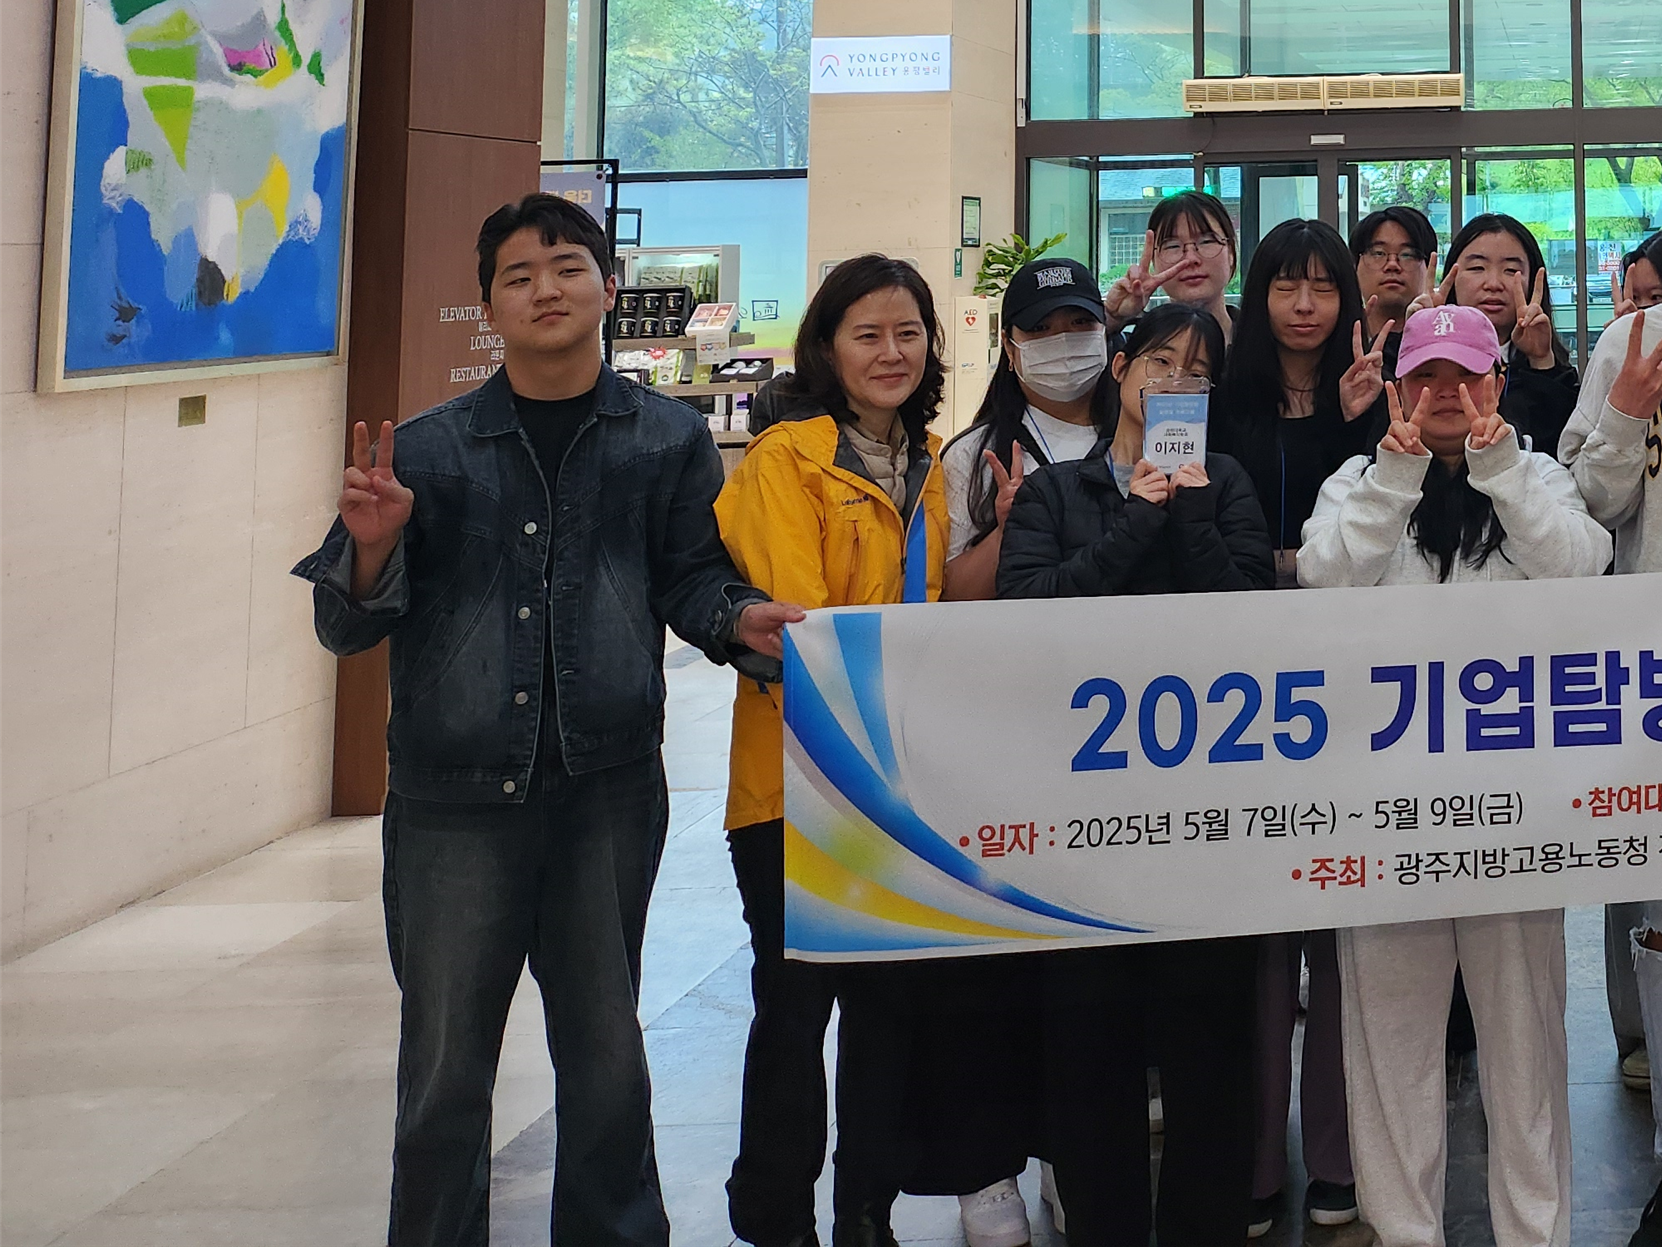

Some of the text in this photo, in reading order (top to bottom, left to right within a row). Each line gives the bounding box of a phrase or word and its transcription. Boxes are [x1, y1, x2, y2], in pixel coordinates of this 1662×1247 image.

[848, 52, 941, 63] YONGPYONG
[848, 67, 898, 77] VALLEY
[439, 306, 482, 322] ELEVATOR
[470, 334, 506, 351] LOUNGE
[1155, 441, 1195, 456] 이지현
[1070, 669, 1329, 773] 2025
[977, 821, 1040, 859] 일자
[1066, 811, 1171, 850] 2025년
[1183, 807, 1230, 842] 5월
[1241, 800, 1337, 838] 7일(수)
[1374, 797, 1419, 831] 5월
[1430, 791, 1523, 828] 9일(금)
[1308, 855, 1366, 891] 주최
[1393, 835, 1648, 886] 광주지방고용노동청
